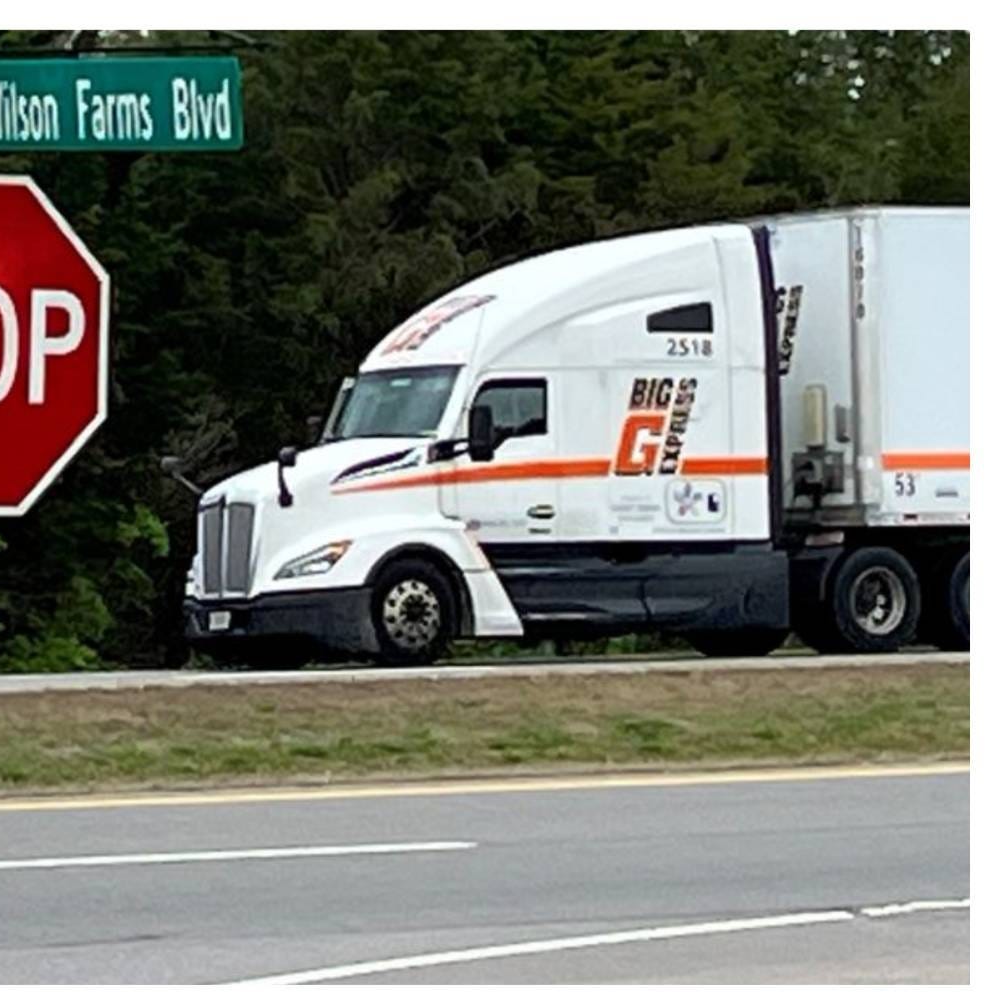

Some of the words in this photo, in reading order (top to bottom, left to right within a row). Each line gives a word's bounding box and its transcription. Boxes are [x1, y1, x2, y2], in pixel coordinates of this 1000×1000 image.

[76, 78, 151, 140] Farms
[173, 77, 231, 140] Blvd
[666, 338, 713, 357] 2518
[629, 377, 674, 410] BIG
[614, 415, 666, 477] G
[658, 377, 698, 475] EXPRESS
